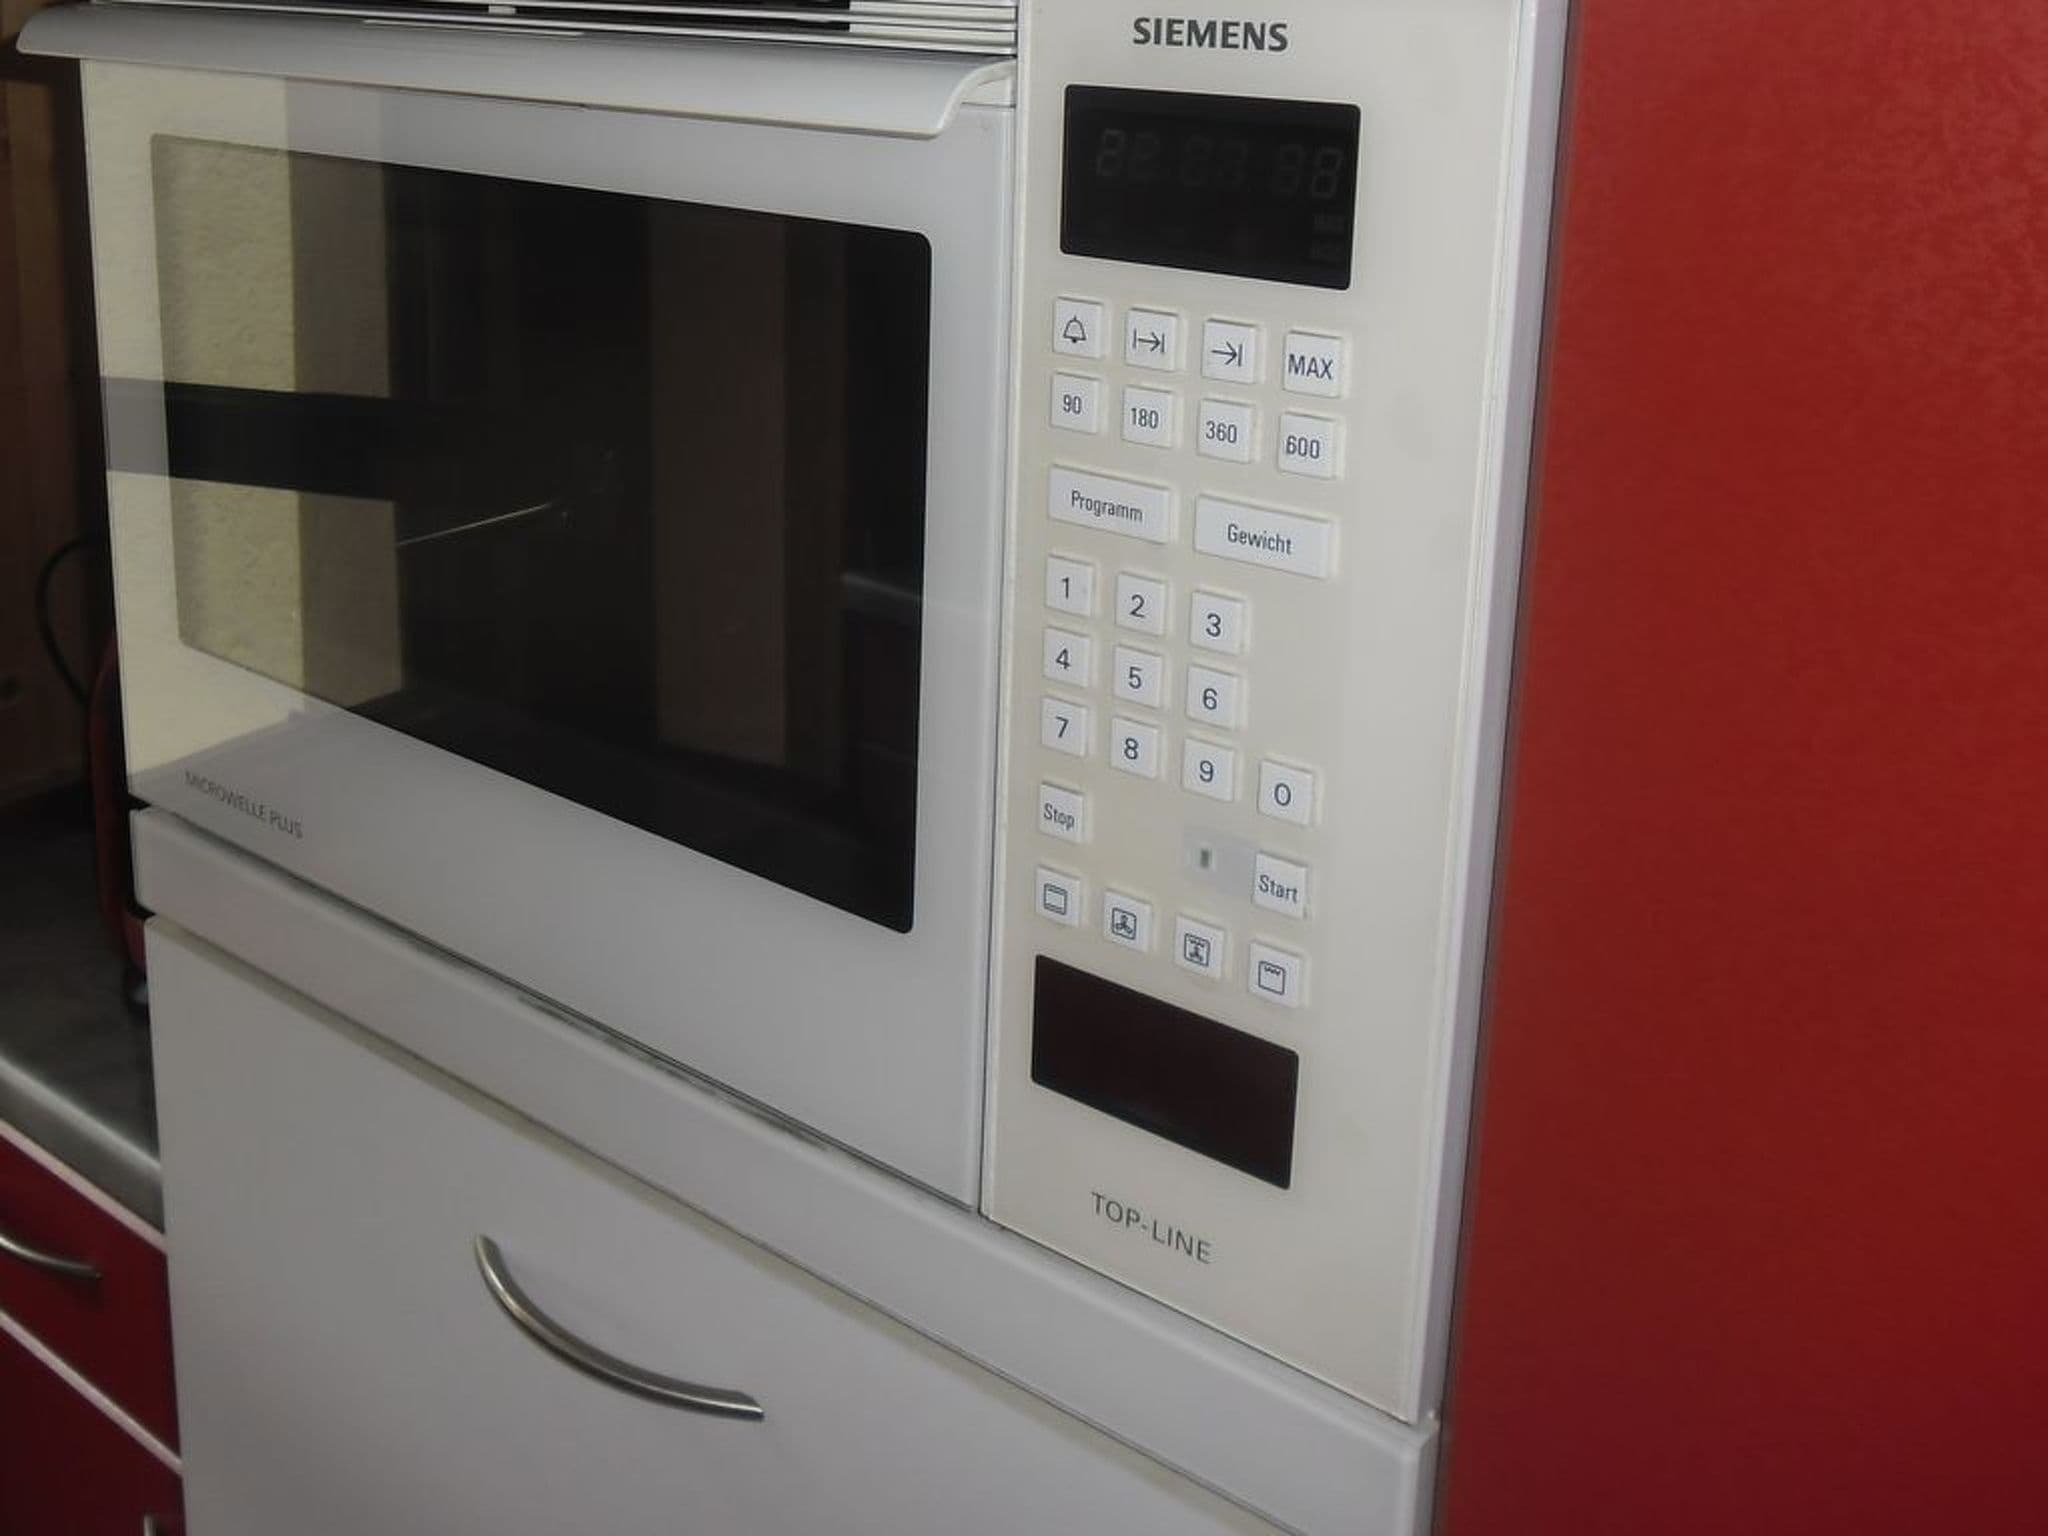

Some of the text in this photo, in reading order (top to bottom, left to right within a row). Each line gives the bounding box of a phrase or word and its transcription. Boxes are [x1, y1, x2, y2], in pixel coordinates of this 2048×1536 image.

[1132, 16, 1289, 52] SIEMENS
[1287, 353, 1334, 381] MAX
[1062, 393, 1082, 415] 90
[1130, 407, 1159, 430] 180
[1205, 420, 1238, 444] 360
[1285, 434, 1320, 460] 600
[1070, 489, 1144, 523] Programm
[1226, 523, 1292, 555] Gewicht
[1060, 576, 1071, 600] 1
[1129, 593, 1146, 618] 2
[1205, 612, 1222, 638] 3
[1055, 647, 1071, 670] 4
[1127, 666, 1142, 690] 5
[1201, 687, 1218, 711] 6
[1054, 716, 1070, 739] 7
[1123, 737, 1139, 761] 8
[1199, 759, 1215, 783] 9
[183, 769, 304, 840] MICROWELLE PLUS
[1273, 782, 1292, 807] 0
[1042, 802, 1075, 831] Stop
[1258, 873, 1299, 904] Start
[1090, 1190, 1214, 1266] TOP-LINE
